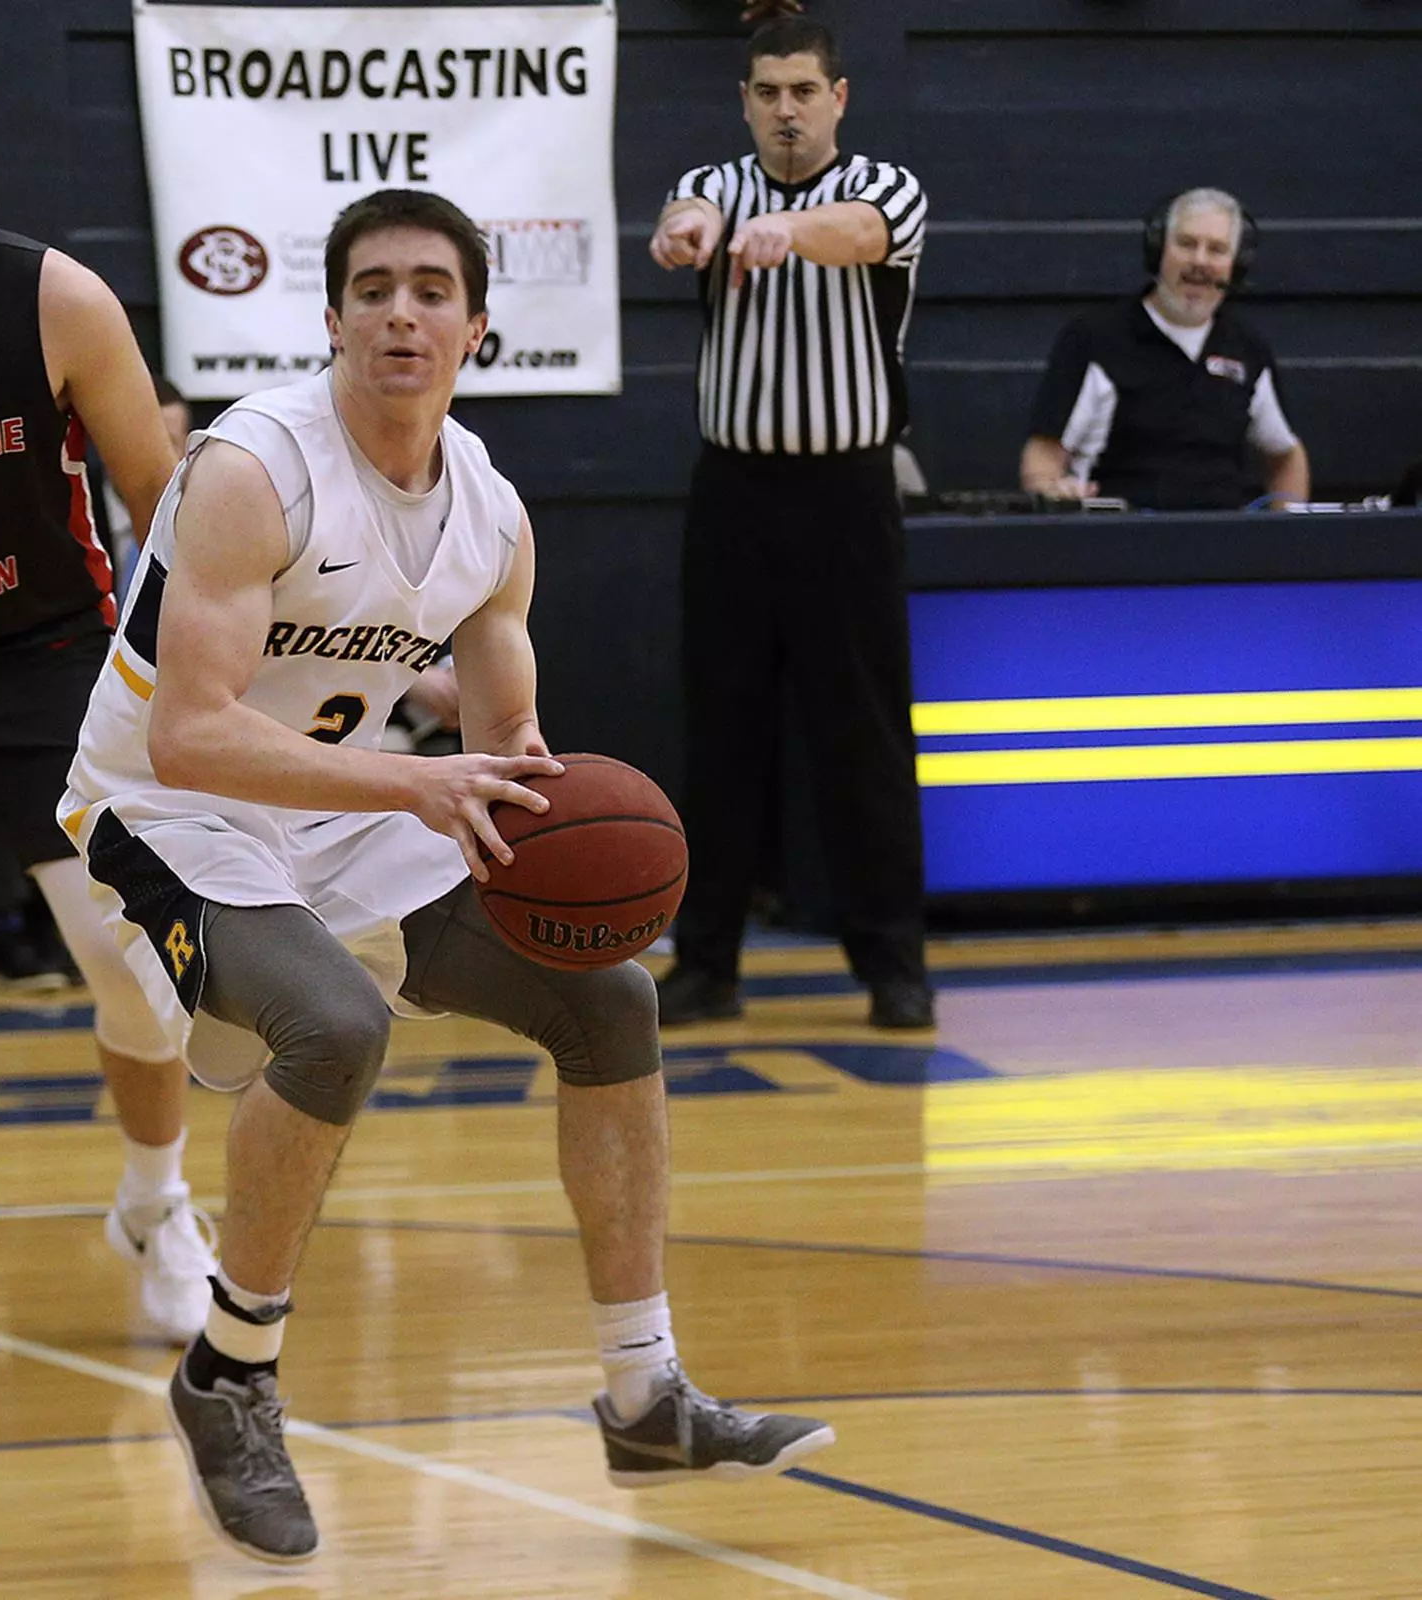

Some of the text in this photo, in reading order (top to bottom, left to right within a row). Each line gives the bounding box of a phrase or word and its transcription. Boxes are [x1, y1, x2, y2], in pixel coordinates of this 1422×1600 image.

[168, 46, 589, 101] BROADCASTING
[321, 131, 430, 182] LIVE
[262, 620, 442, 675] ROCHESTE
[527, 911, 668, 953] Wilson
